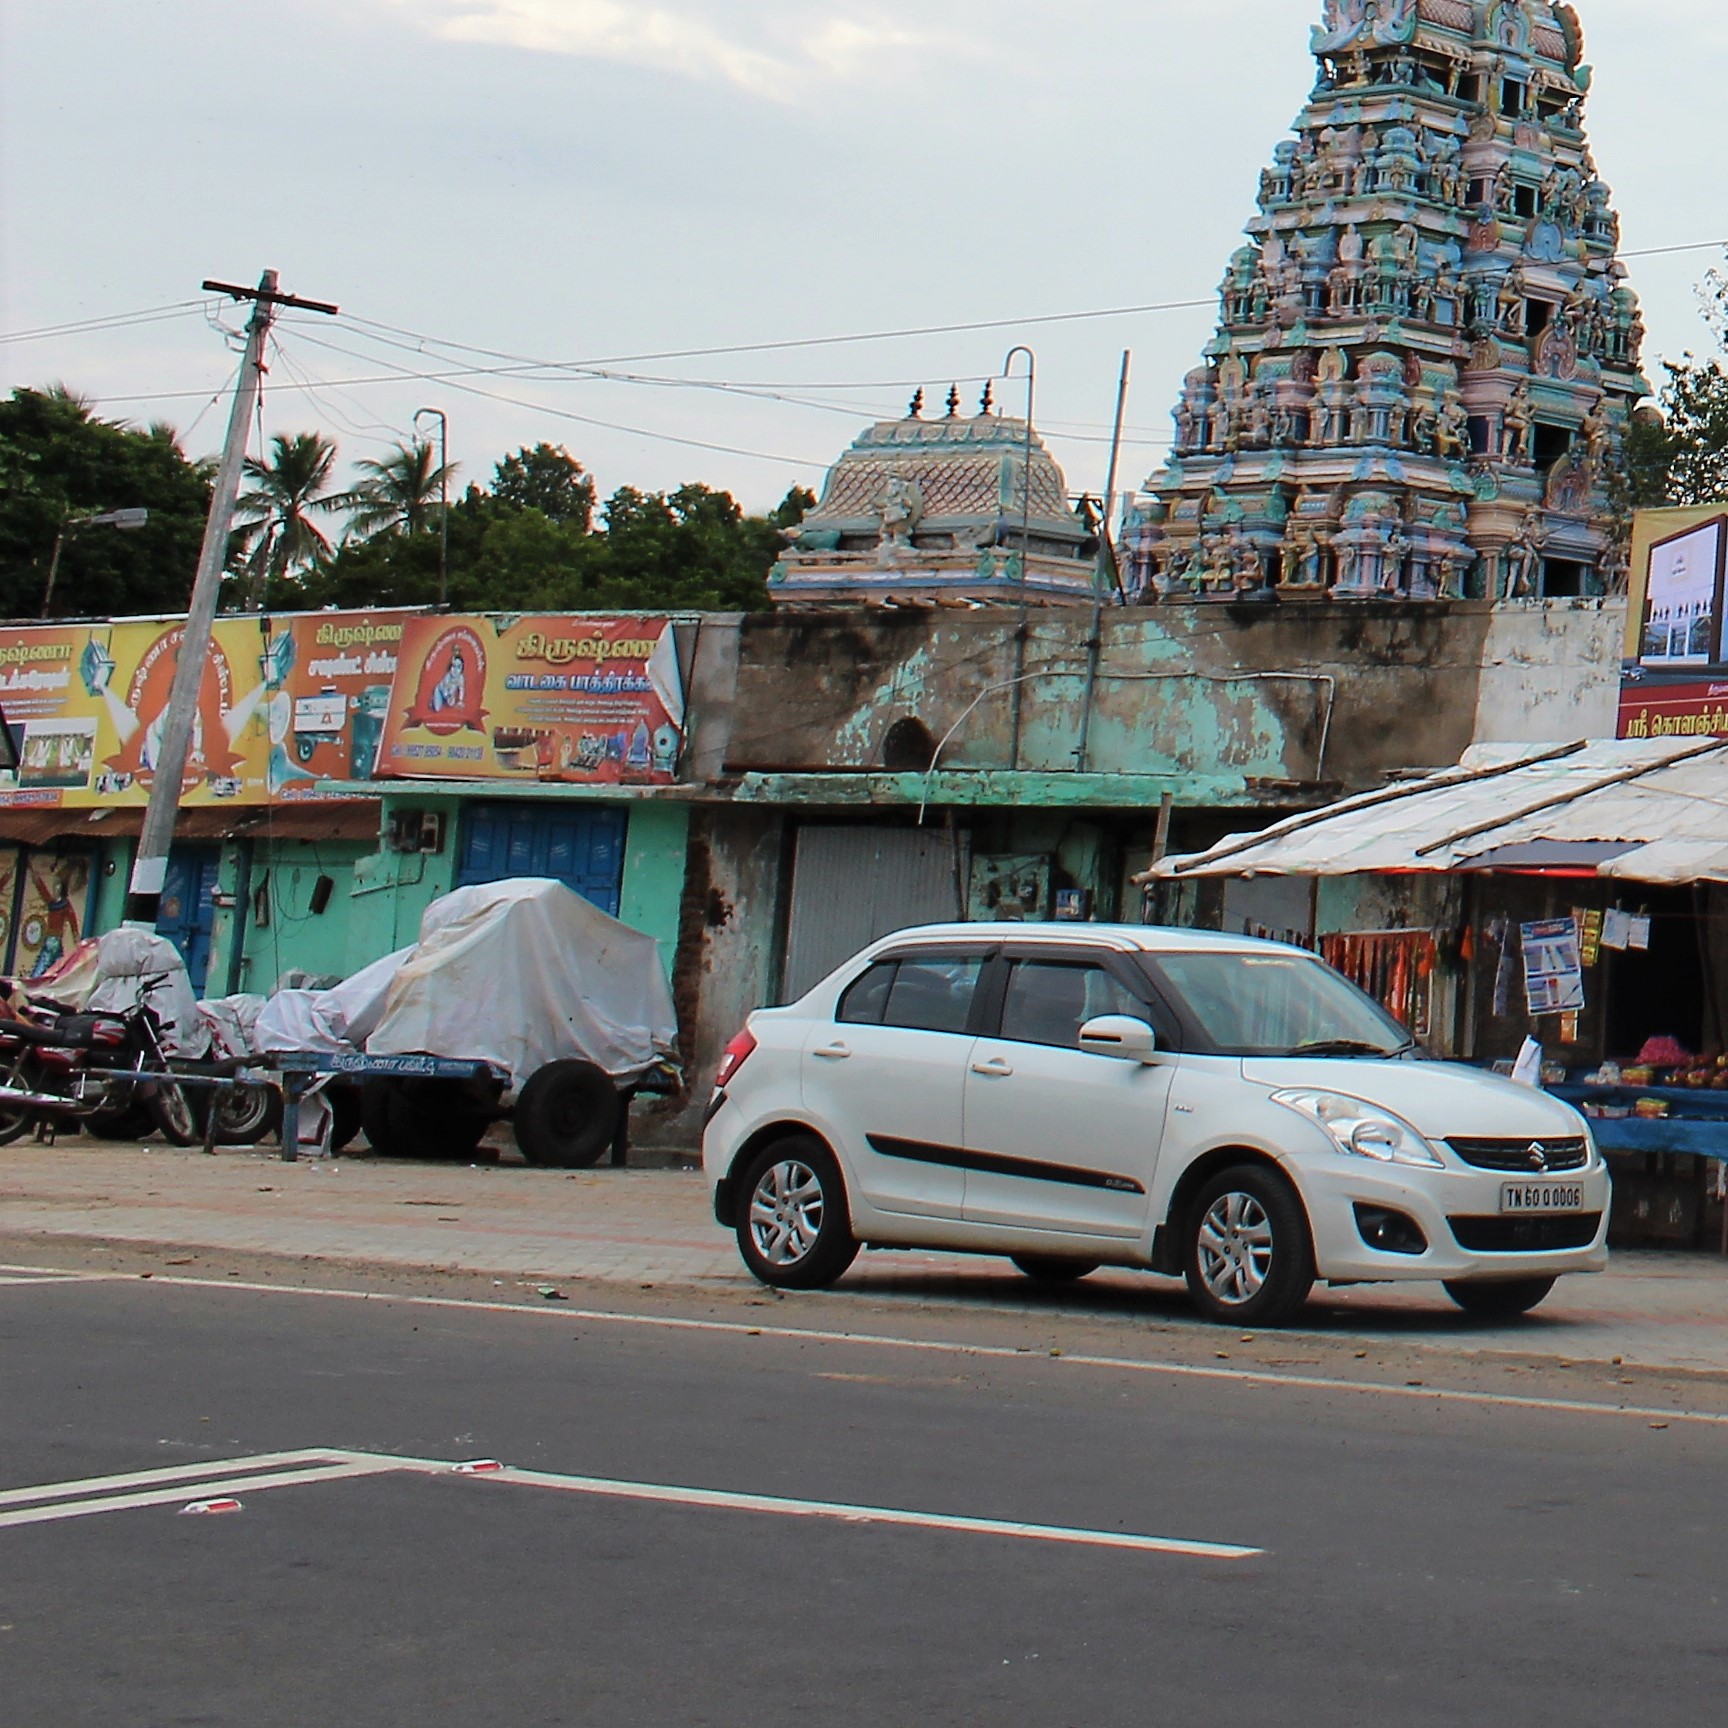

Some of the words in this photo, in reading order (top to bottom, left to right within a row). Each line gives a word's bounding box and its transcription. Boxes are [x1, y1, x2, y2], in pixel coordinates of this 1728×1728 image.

[316, 618, 403, 647] கிருஷ்ண
[516, 629, 657, 665] கிருஷ்ண
[1507, 1188, 1522, 1206] TN
